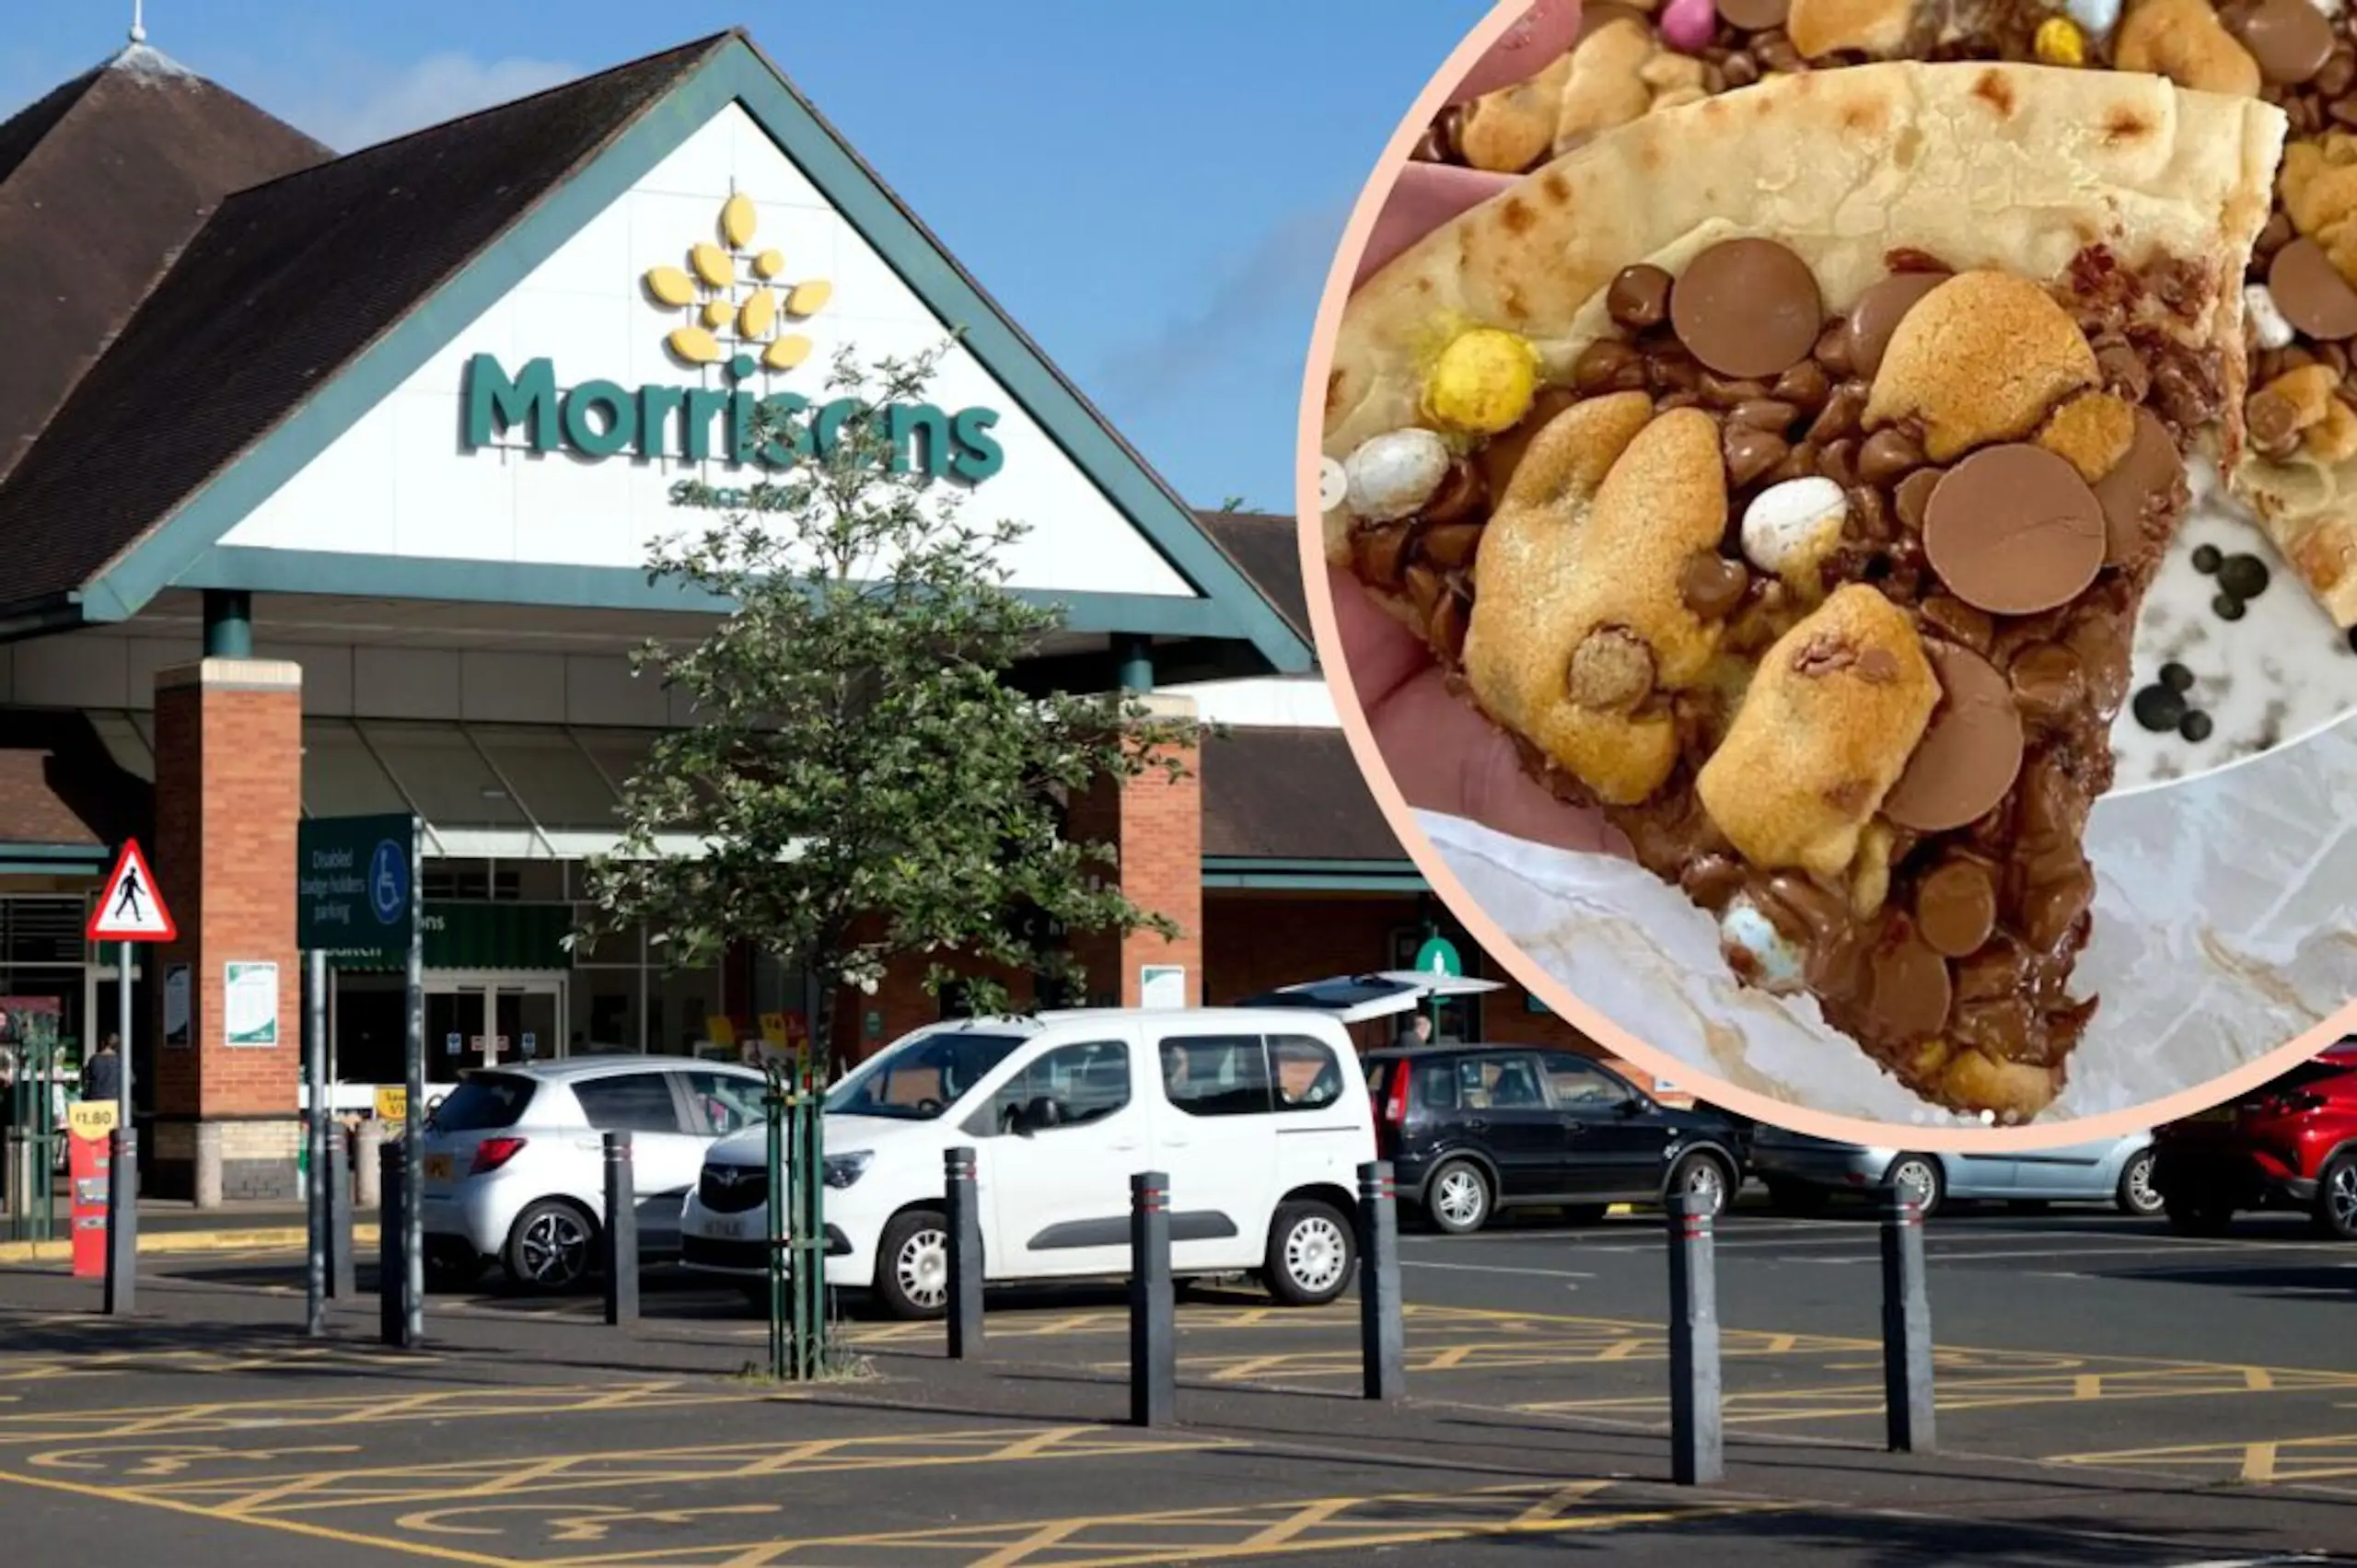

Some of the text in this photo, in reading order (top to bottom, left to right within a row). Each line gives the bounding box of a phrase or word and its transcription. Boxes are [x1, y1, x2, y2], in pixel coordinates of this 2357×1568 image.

[465, 353, 1005, 482] Morrisons
[313, 848, 354, 868] Disabled
[315, 902, 352, 924] parking
